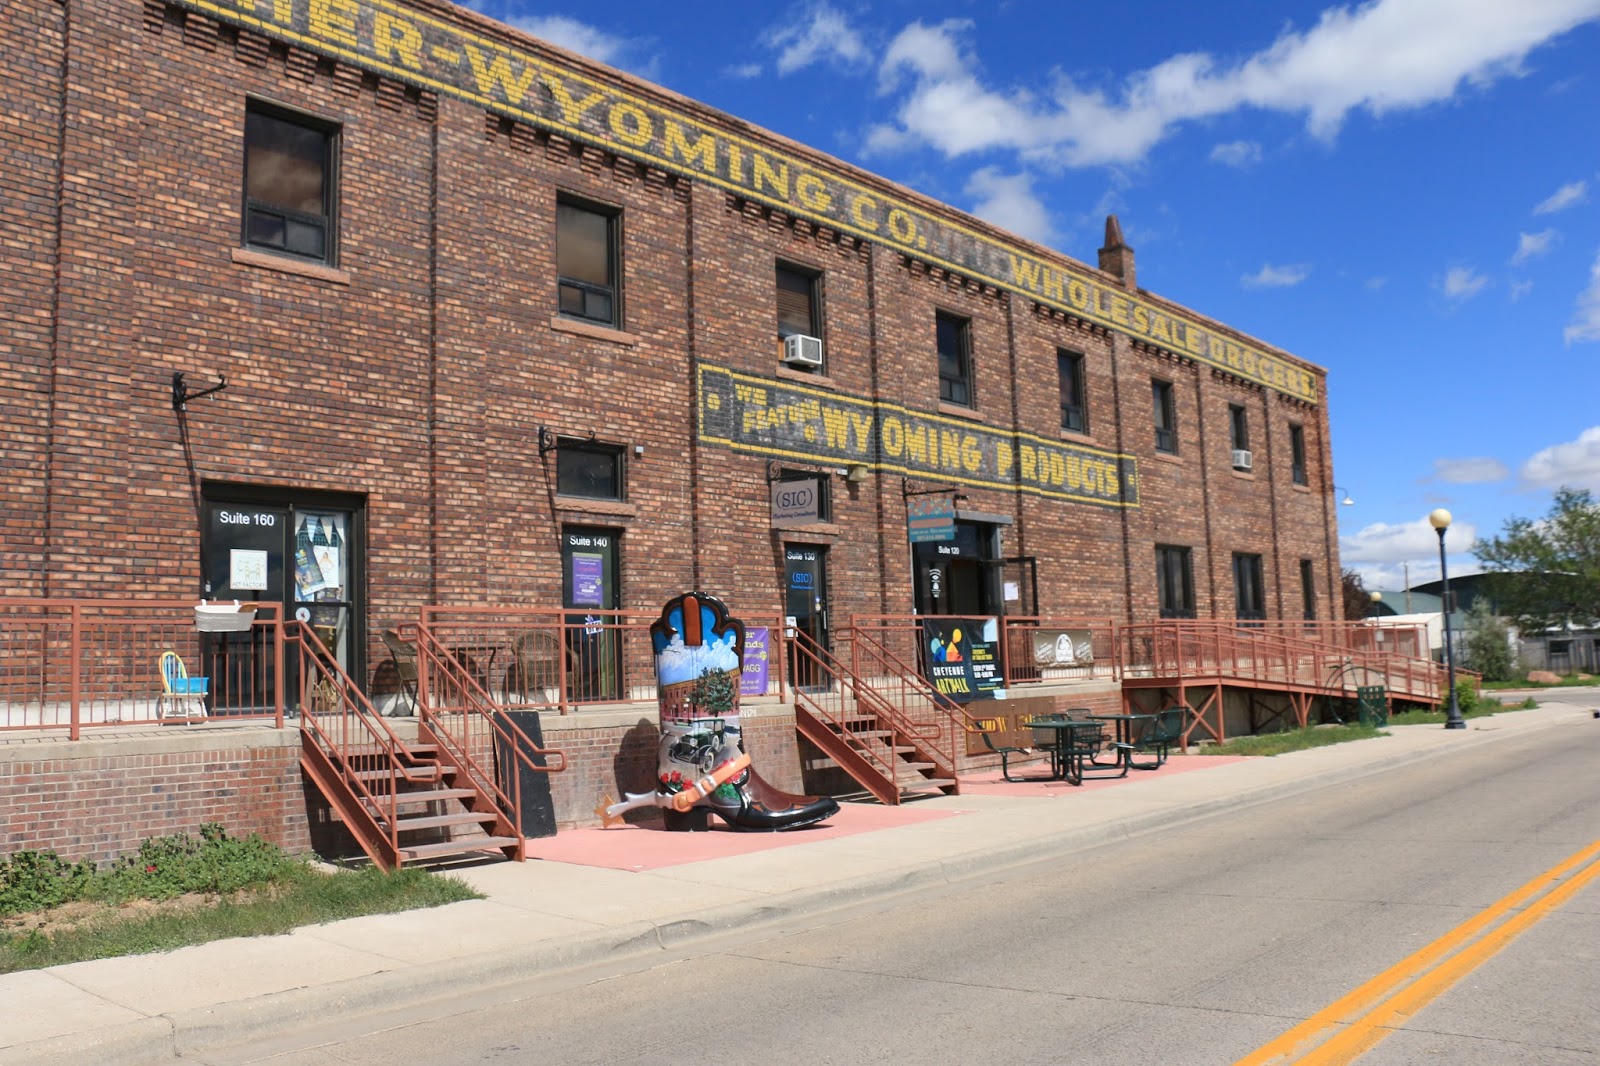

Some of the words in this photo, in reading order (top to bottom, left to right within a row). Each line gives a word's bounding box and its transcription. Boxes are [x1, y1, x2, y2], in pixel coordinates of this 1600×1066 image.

[237, 0, 833, 213] ER-WYOMING
[850, 194, 927, 250] CO.
[1009, 254, 1200, 354] WHOLESALE
[735, 383, 767, 406] WE
[822, 405, 982, 472] WYOMING
[997, 441, 1119, 496] PRODUCTS
[776, 487, 813, 510] (SIC)
[220, 511, 250, 525] Suite
[254, 513, 275, 526] 160
[570, 535, 591, 547] Suite
[593, 537, 608, 548] 140
[787, 551, 803, 561] Suite
[804, 552, 815, 562] 130
[938, 545, 951, 554] Suite
[951, 546, 960, 555] 120
[932, 666, 965, 677] CHEYENNE
[936, 678, 970, 694] ARTWALK
